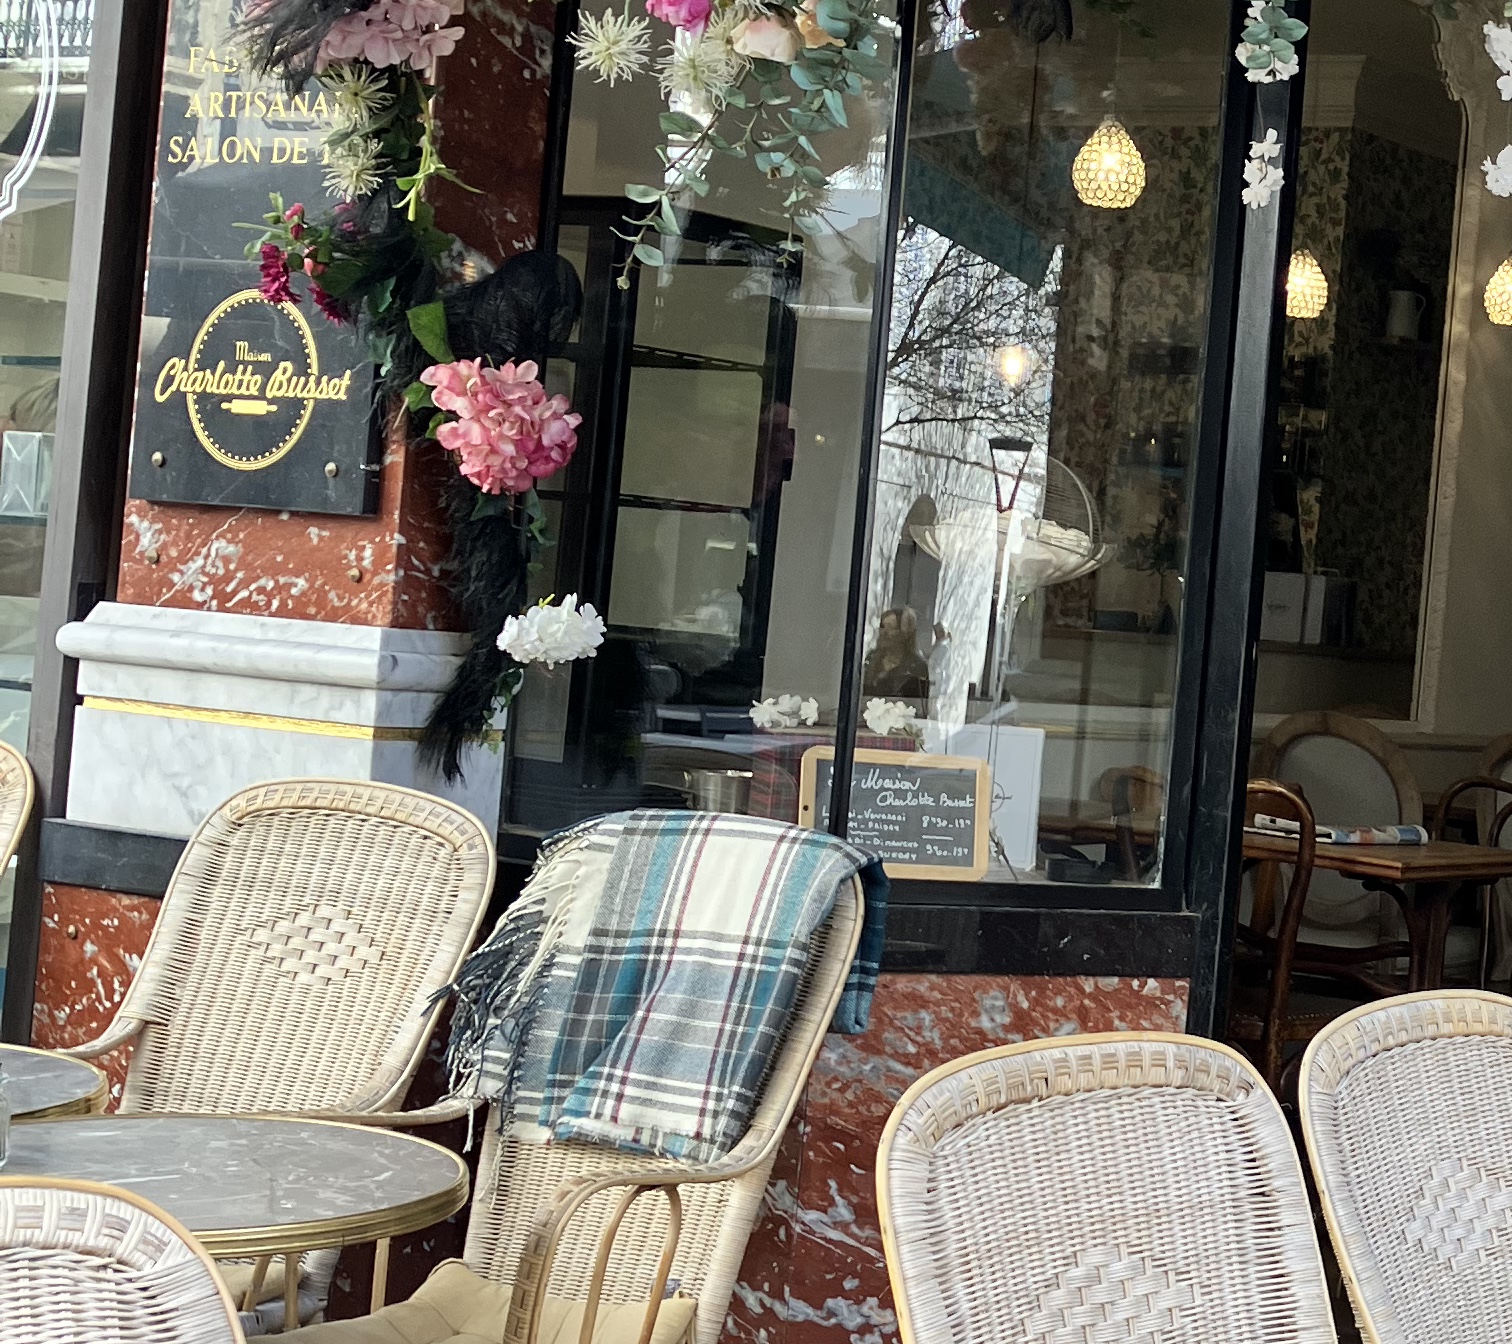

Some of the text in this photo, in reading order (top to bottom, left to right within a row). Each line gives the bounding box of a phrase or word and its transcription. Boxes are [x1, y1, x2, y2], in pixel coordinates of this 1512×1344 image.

[167, 135, 262, 164] SALON
[270, 136, 308, 165] DE
[234, 340, 273, 362] Maison
[154, 357, 351, 402] Charlotte Busset
